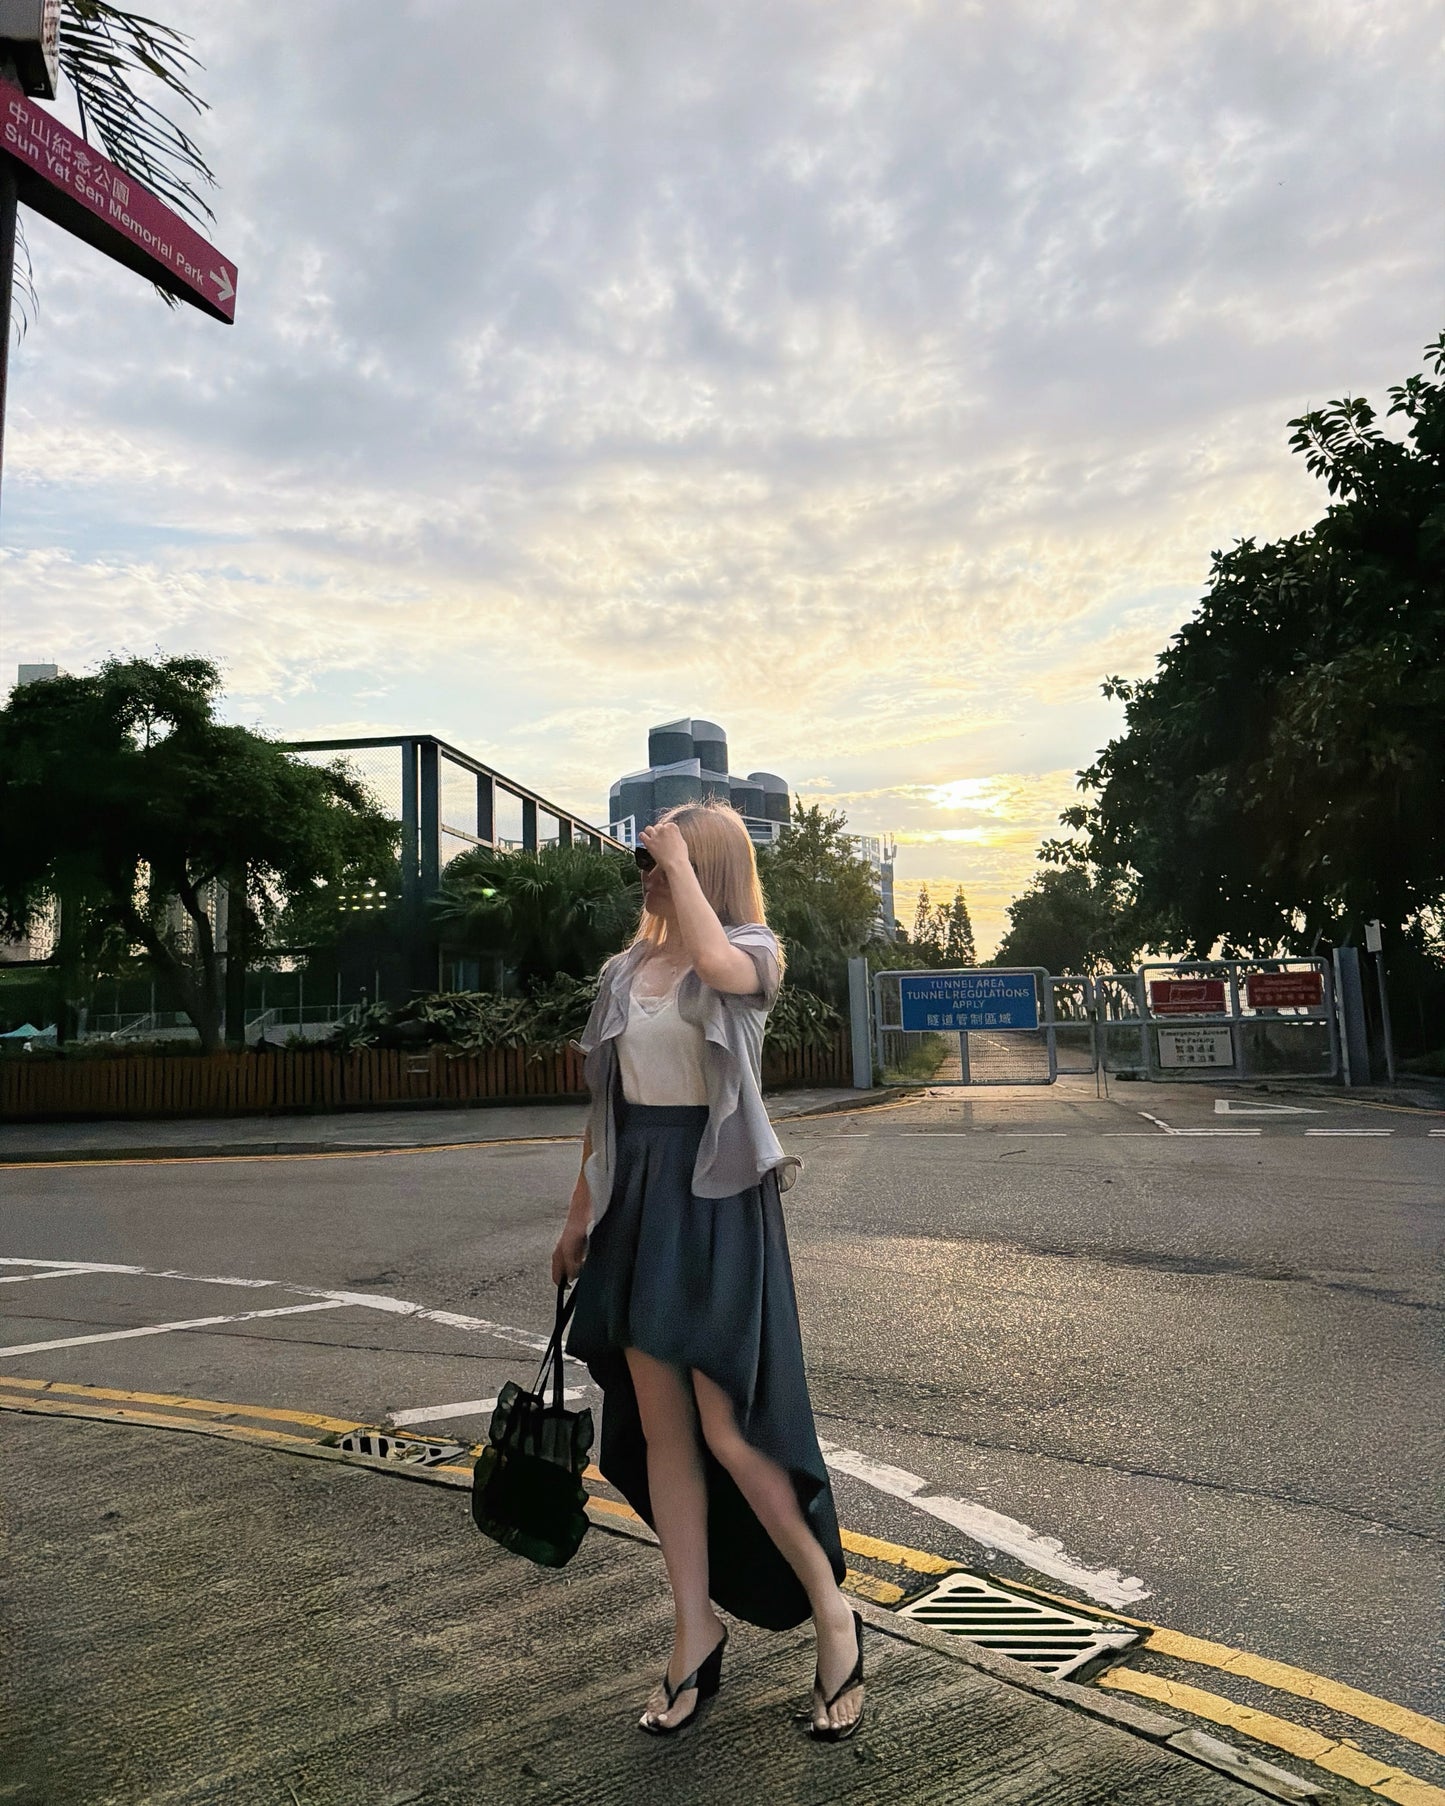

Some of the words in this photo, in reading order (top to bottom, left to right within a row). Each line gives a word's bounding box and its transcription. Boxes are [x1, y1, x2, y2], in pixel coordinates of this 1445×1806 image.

[9, 101, 130, 207] 中山紀念公園
[4, 123, 40, 160] Sun
[43, 152, 71, 183] Yat
[75, 175, 105, 208] Sen
[108, 201, 173, 260] Memorial
[176, 252, 205, 286] Park
[930, 980, 974, 989] TUNNEL
[976, 979, 1005, 988] AREA
[906, 990, 952, 1000] TUNNEL
[953, 988, 1030, 999] REGULATIONS
[952, 1000, 985, 1009] APPLY
[926, 1012, 1012, 1026] 隧道管制區域
